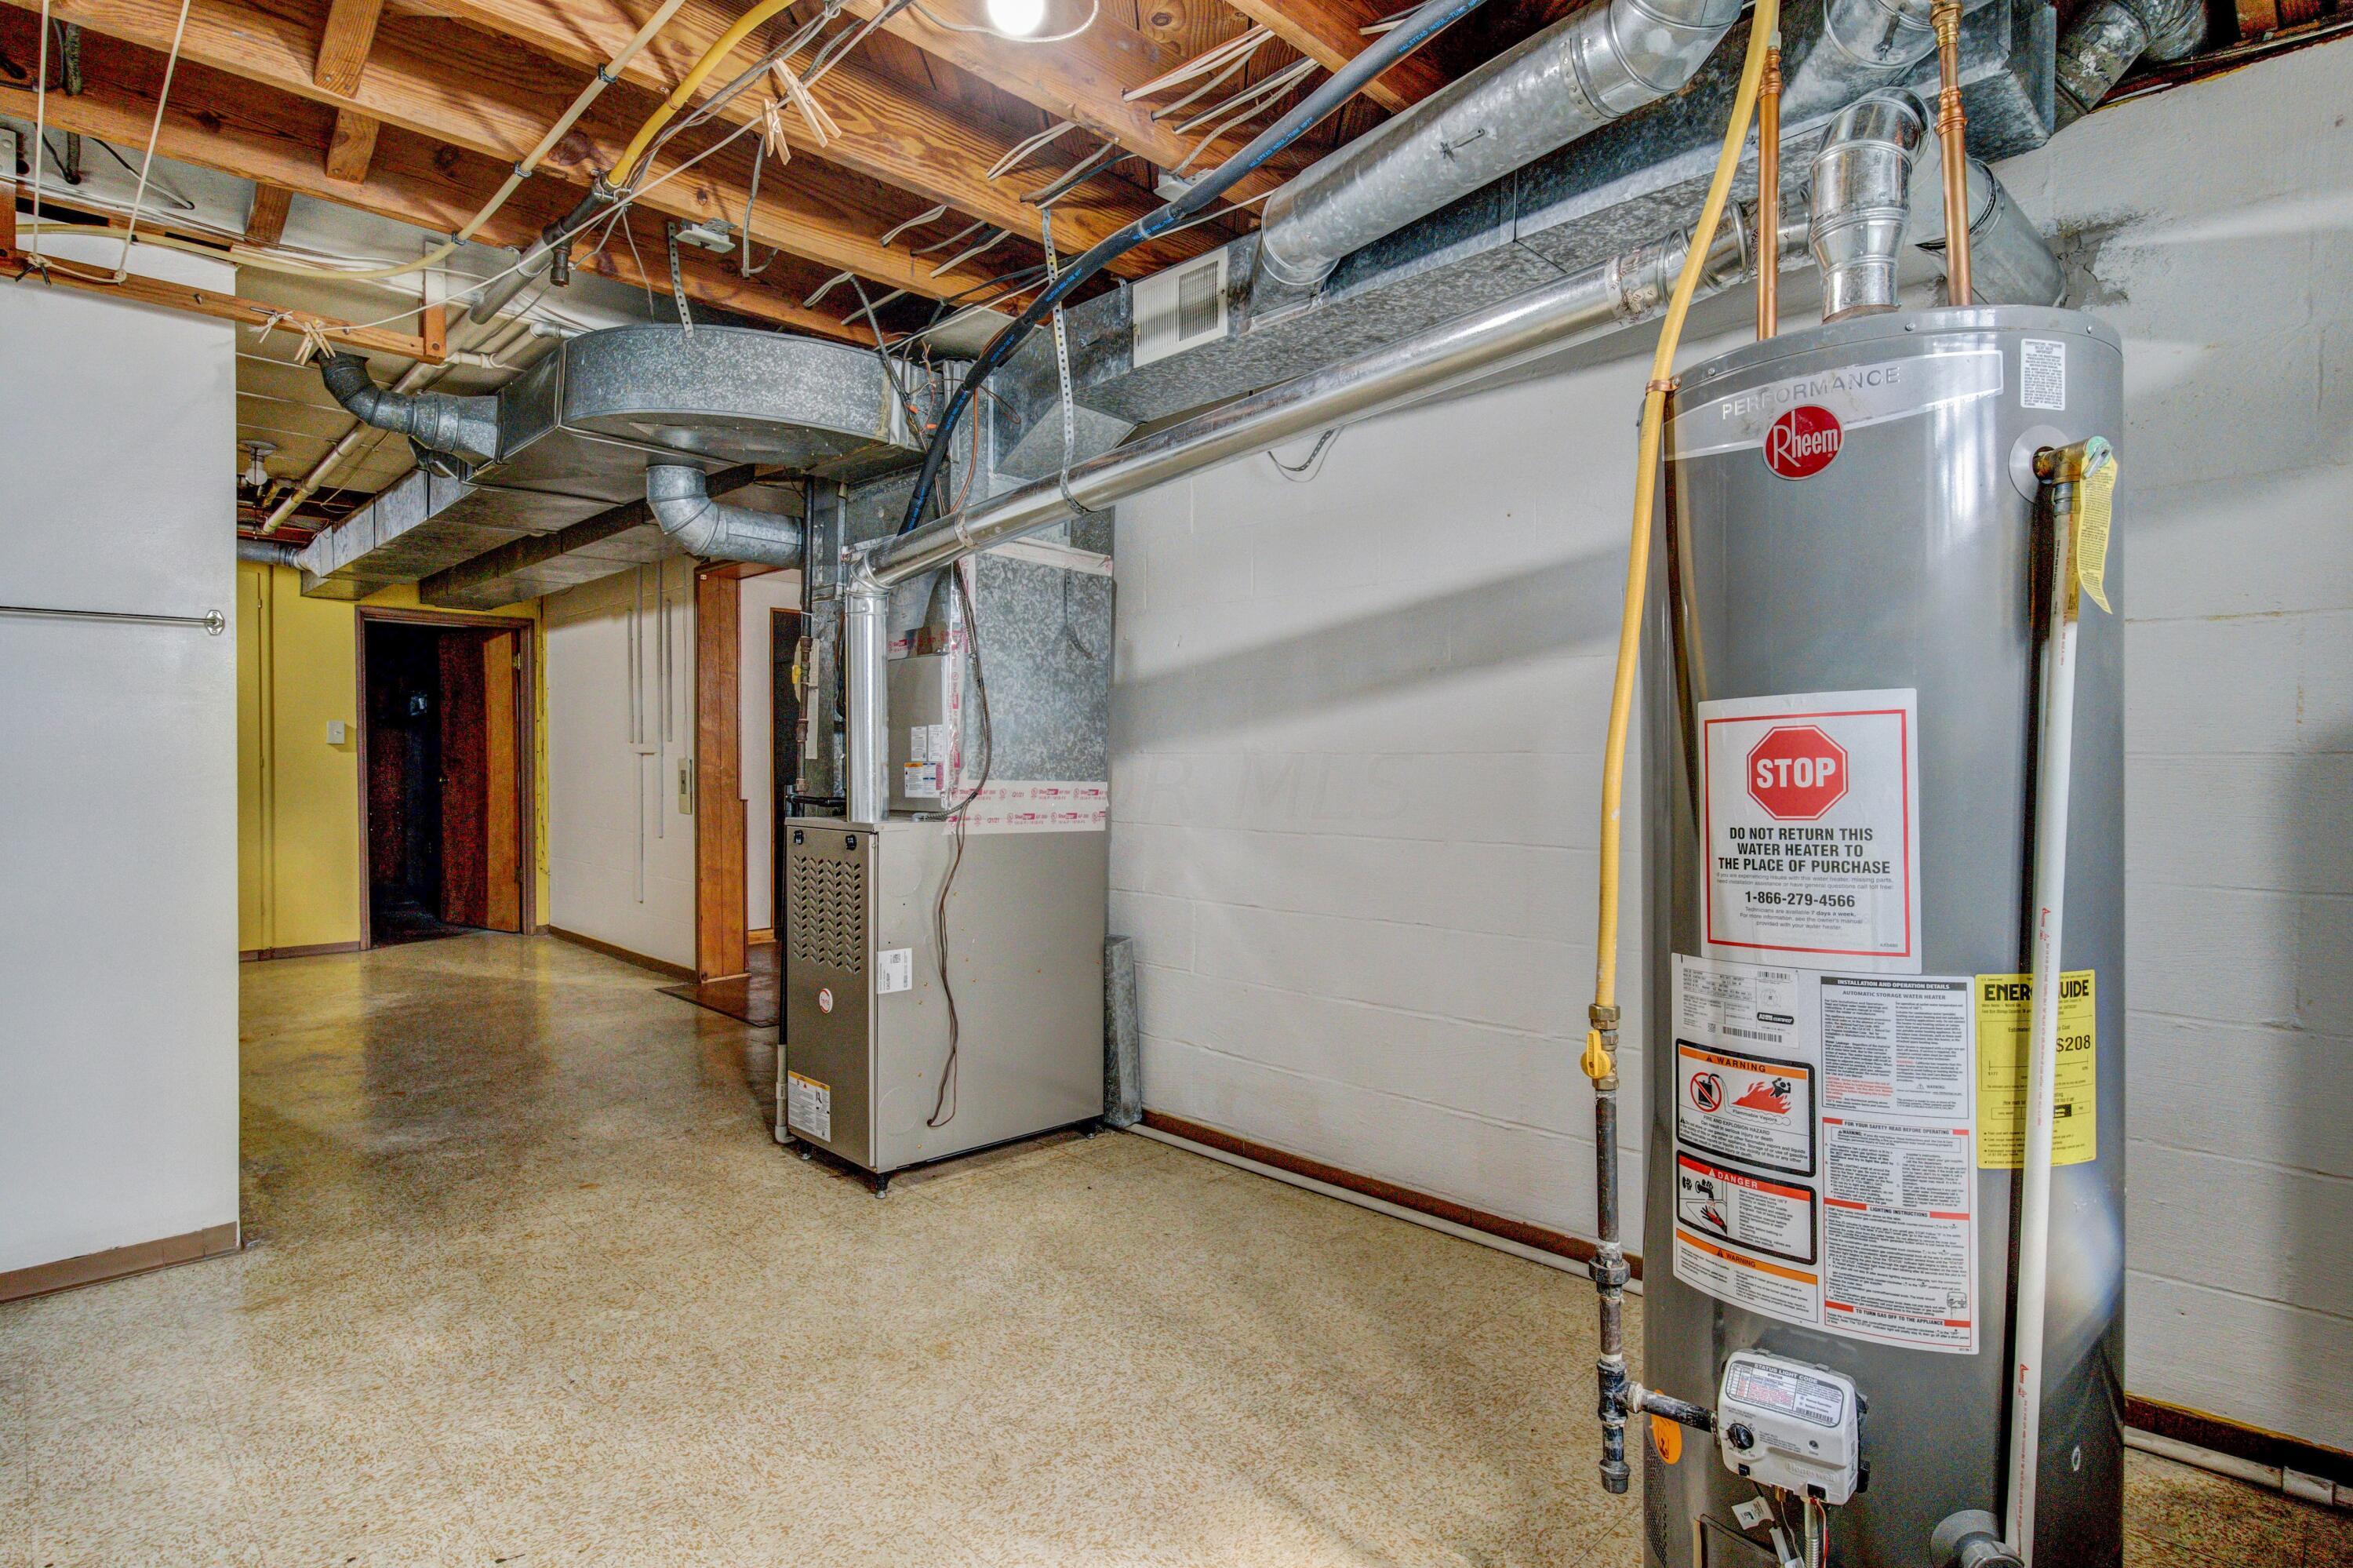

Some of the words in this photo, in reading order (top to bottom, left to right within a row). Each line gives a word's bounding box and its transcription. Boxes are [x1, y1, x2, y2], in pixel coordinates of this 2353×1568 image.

[1722, 366, 1901, 420] PERFORMANCE
[1773, 409, 1838, 470] Rheem
[1756, 757, 1836, 788] STOP
[1729, 827, 1745, 839] DO
[1749, 828, 1774, 840] NOT
[1779, 828, 1834, 841] RETURN
[1838, 828, 1873, 841] THIS
[1737, 842, 1780, 856] WATER
[1784, 843, 1839, 857] HEATER
[1844, 844, 1864, 857] TO
[1718, 857, 1739, 870] THE
[1743, 858, 1784, 871] PLACE
[1788, 860, 1806, 872] OF
[1811, 860, 1890, 874] PURCHASE
[1745, 891, 1856, 908] 1-866-279-4566
[2057, 1035, 2091, 1053] $208
[1716, 1056, 1766, 1073] WARNING
[1722, 1120, 1749, 1131] EXPLOSION
[1749, 1126, 1770, 1135] HAZARD
[1718, 1171, 1758, 1189] DANGER
[1893, 1209, 1928, 1217] INSTRUCTIONS
[1726, 1252, 1756, 1268] WARNING
[1754, 1363, 1778, 1373] STATUS
[1778, 1368, 1798, 1379] LIGHT
[1798, 1374, 1819, 1384] CODE
[1787, 1461, 1836, 1482] Honeywell
